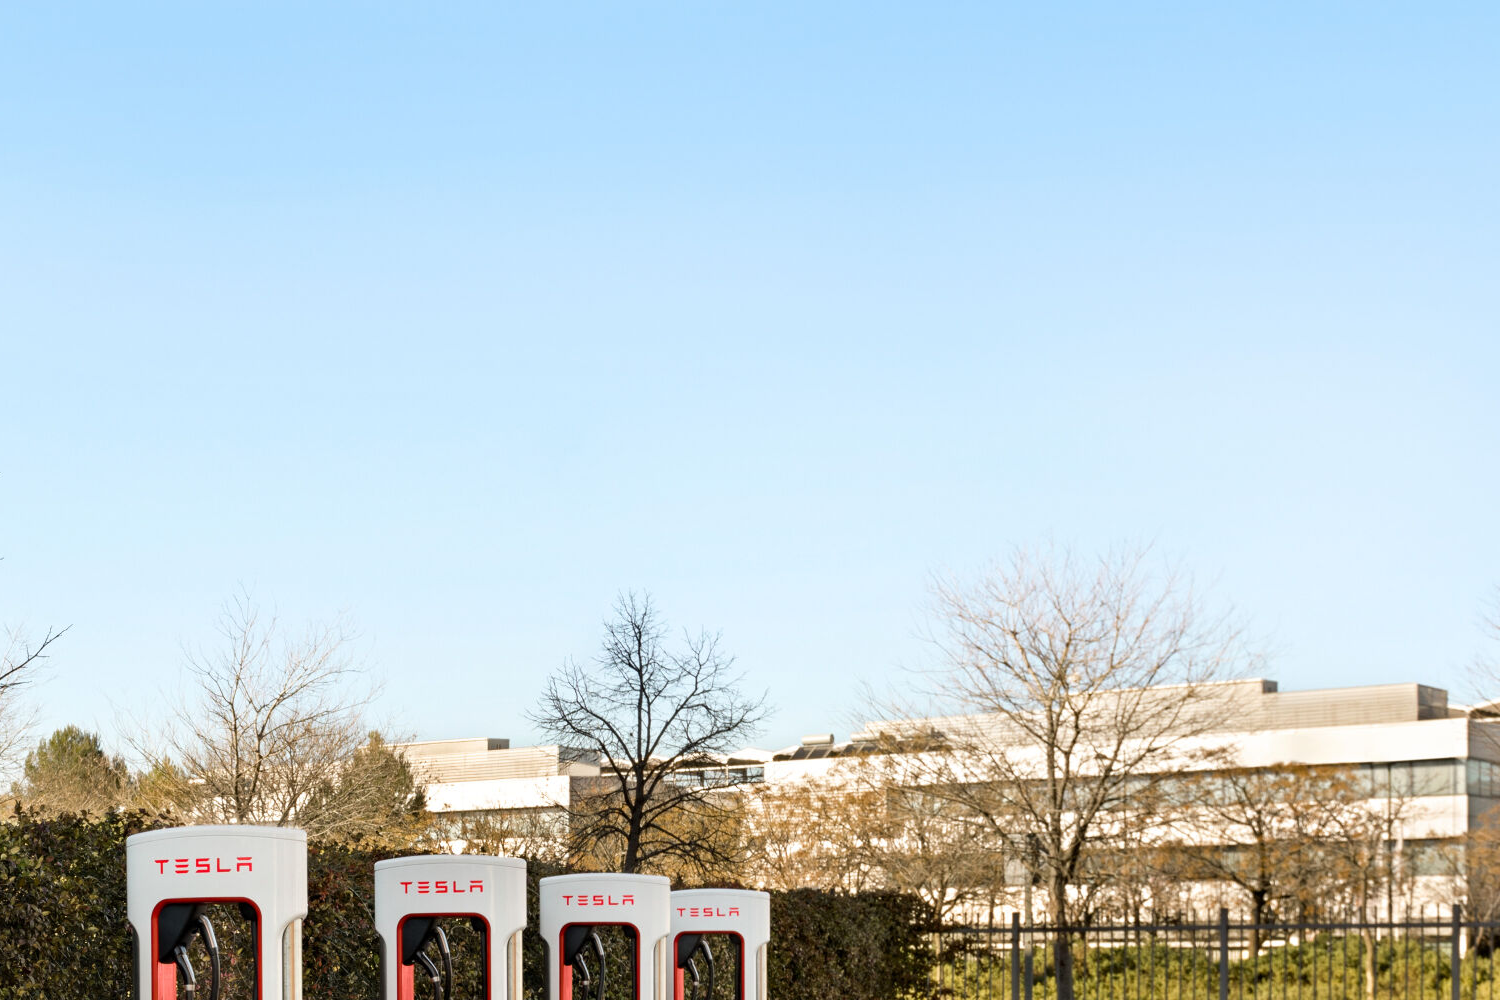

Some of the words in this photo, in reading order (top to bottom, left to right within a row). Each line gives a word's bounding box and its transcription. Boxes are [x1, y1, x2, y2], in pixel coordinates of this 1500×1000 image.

[153, 856, 253, 876] TESLA
[399, 880, 484, 895] TESLA
[561, 894, 635, 907] TESLA
[676, 907, 740, 918] TESLA
